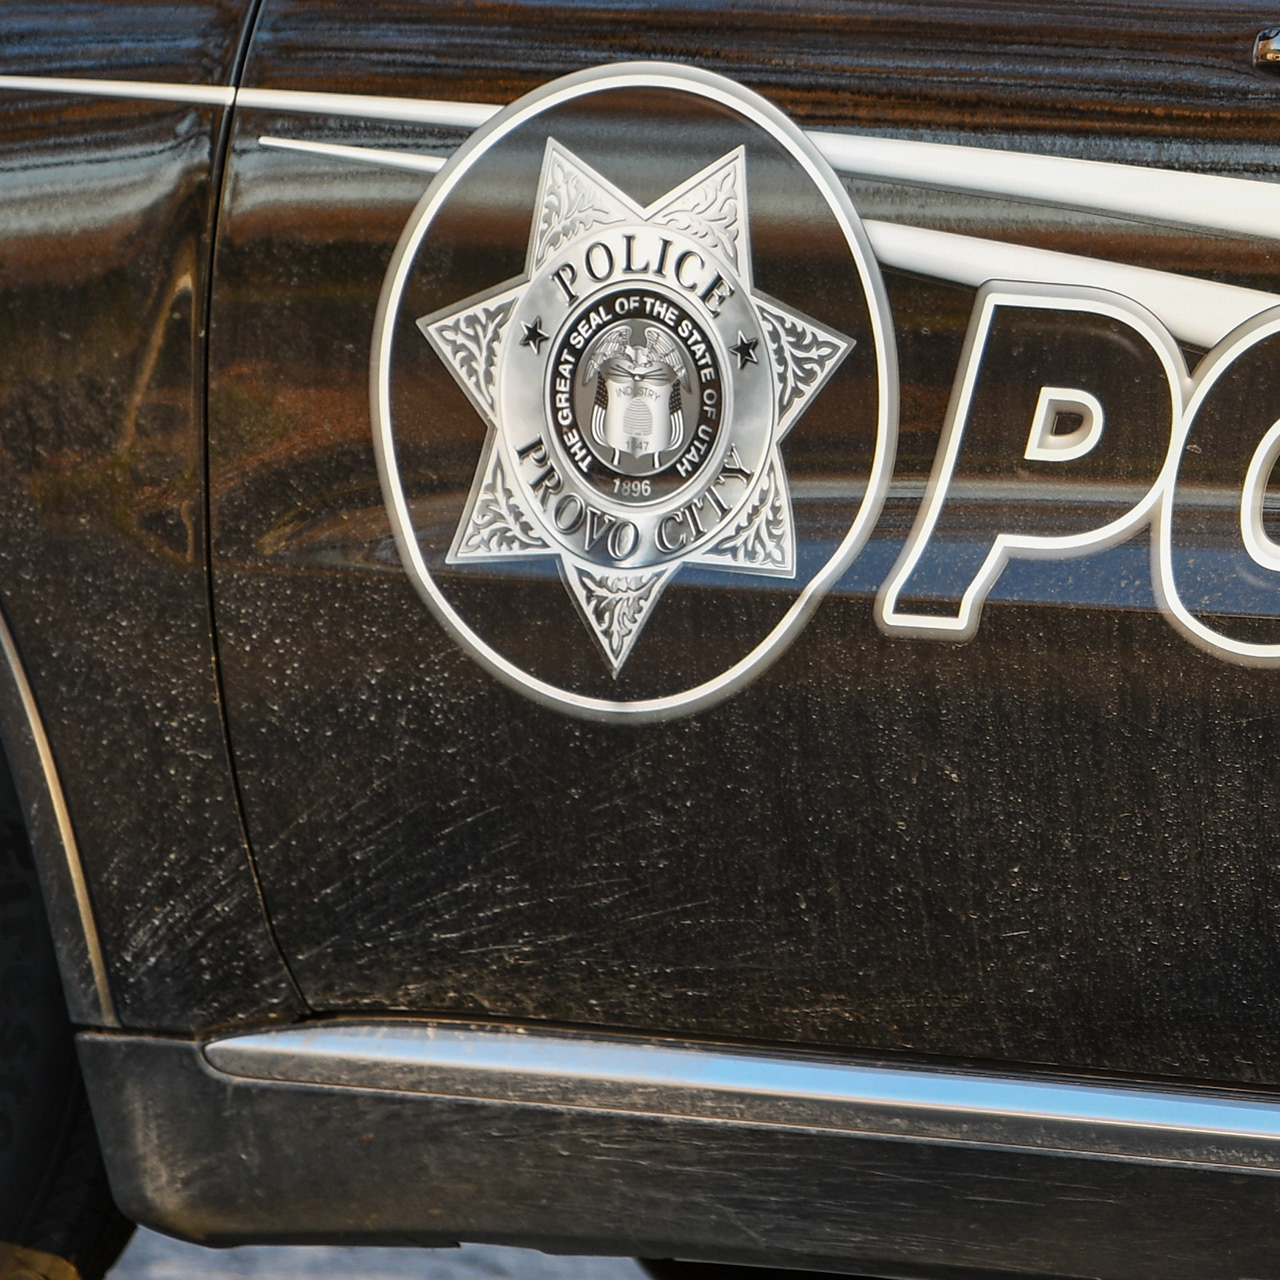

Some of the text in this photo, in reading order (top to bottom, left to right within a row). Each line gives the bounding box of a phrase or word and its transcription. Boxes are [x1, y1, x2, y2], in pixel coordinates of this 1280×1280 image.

[549, 234, 735, 318] POLICE
[555, 296, 718, 478] THE GREAT SEAL OF THE STATE OF UTAH
[615, 386, 661, 401] INDSTRY
[625, 441, 649, 451] 147
[514, 432, 755, 561] PROVO CITY
[612, 477, 651, 497] 1896
